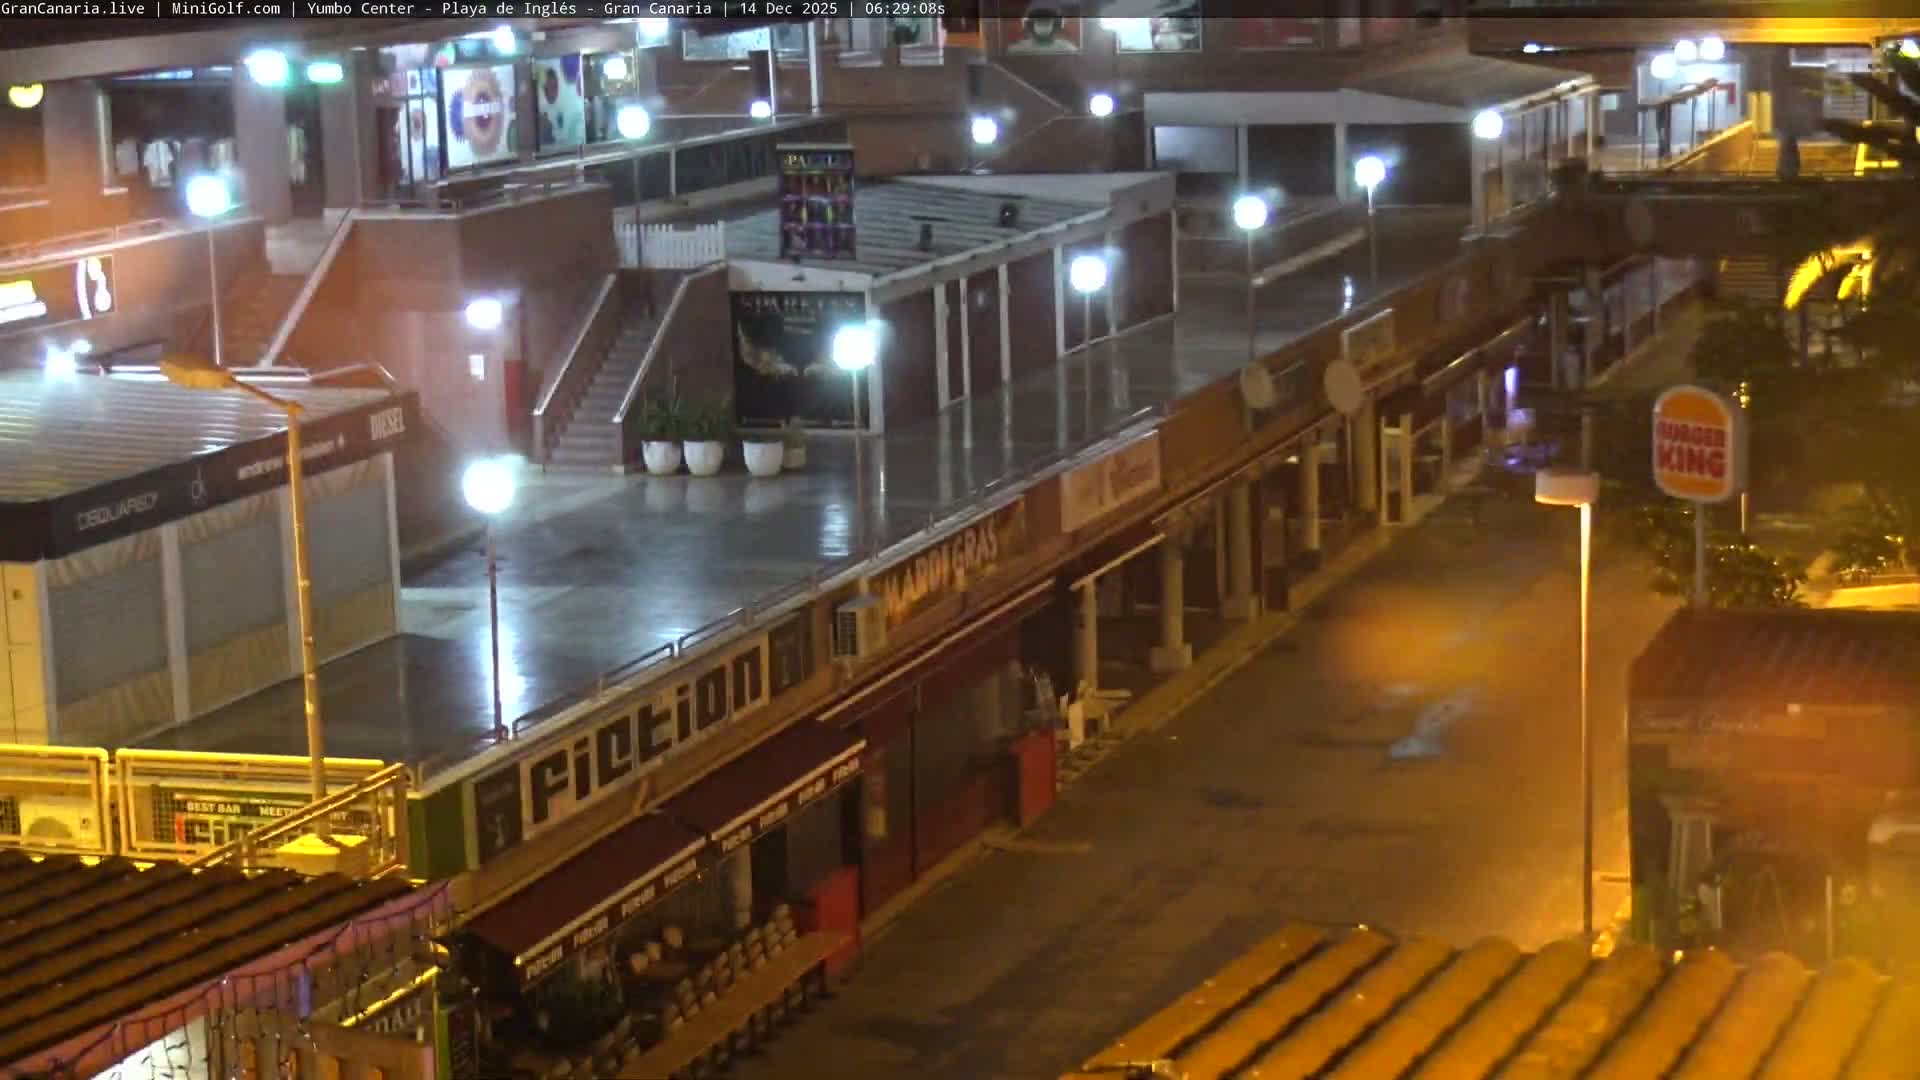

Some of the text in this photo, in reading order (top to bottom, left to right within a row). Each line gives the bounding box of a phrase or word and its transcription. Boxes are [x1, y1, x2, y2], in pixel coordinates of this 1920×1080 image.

[1656, 421, 1726, 448] BURGER
[1656, 445, 1726, 479] KING
[186, 801, 216, 813] BEST
[217, 802, 242, 815] BAR
